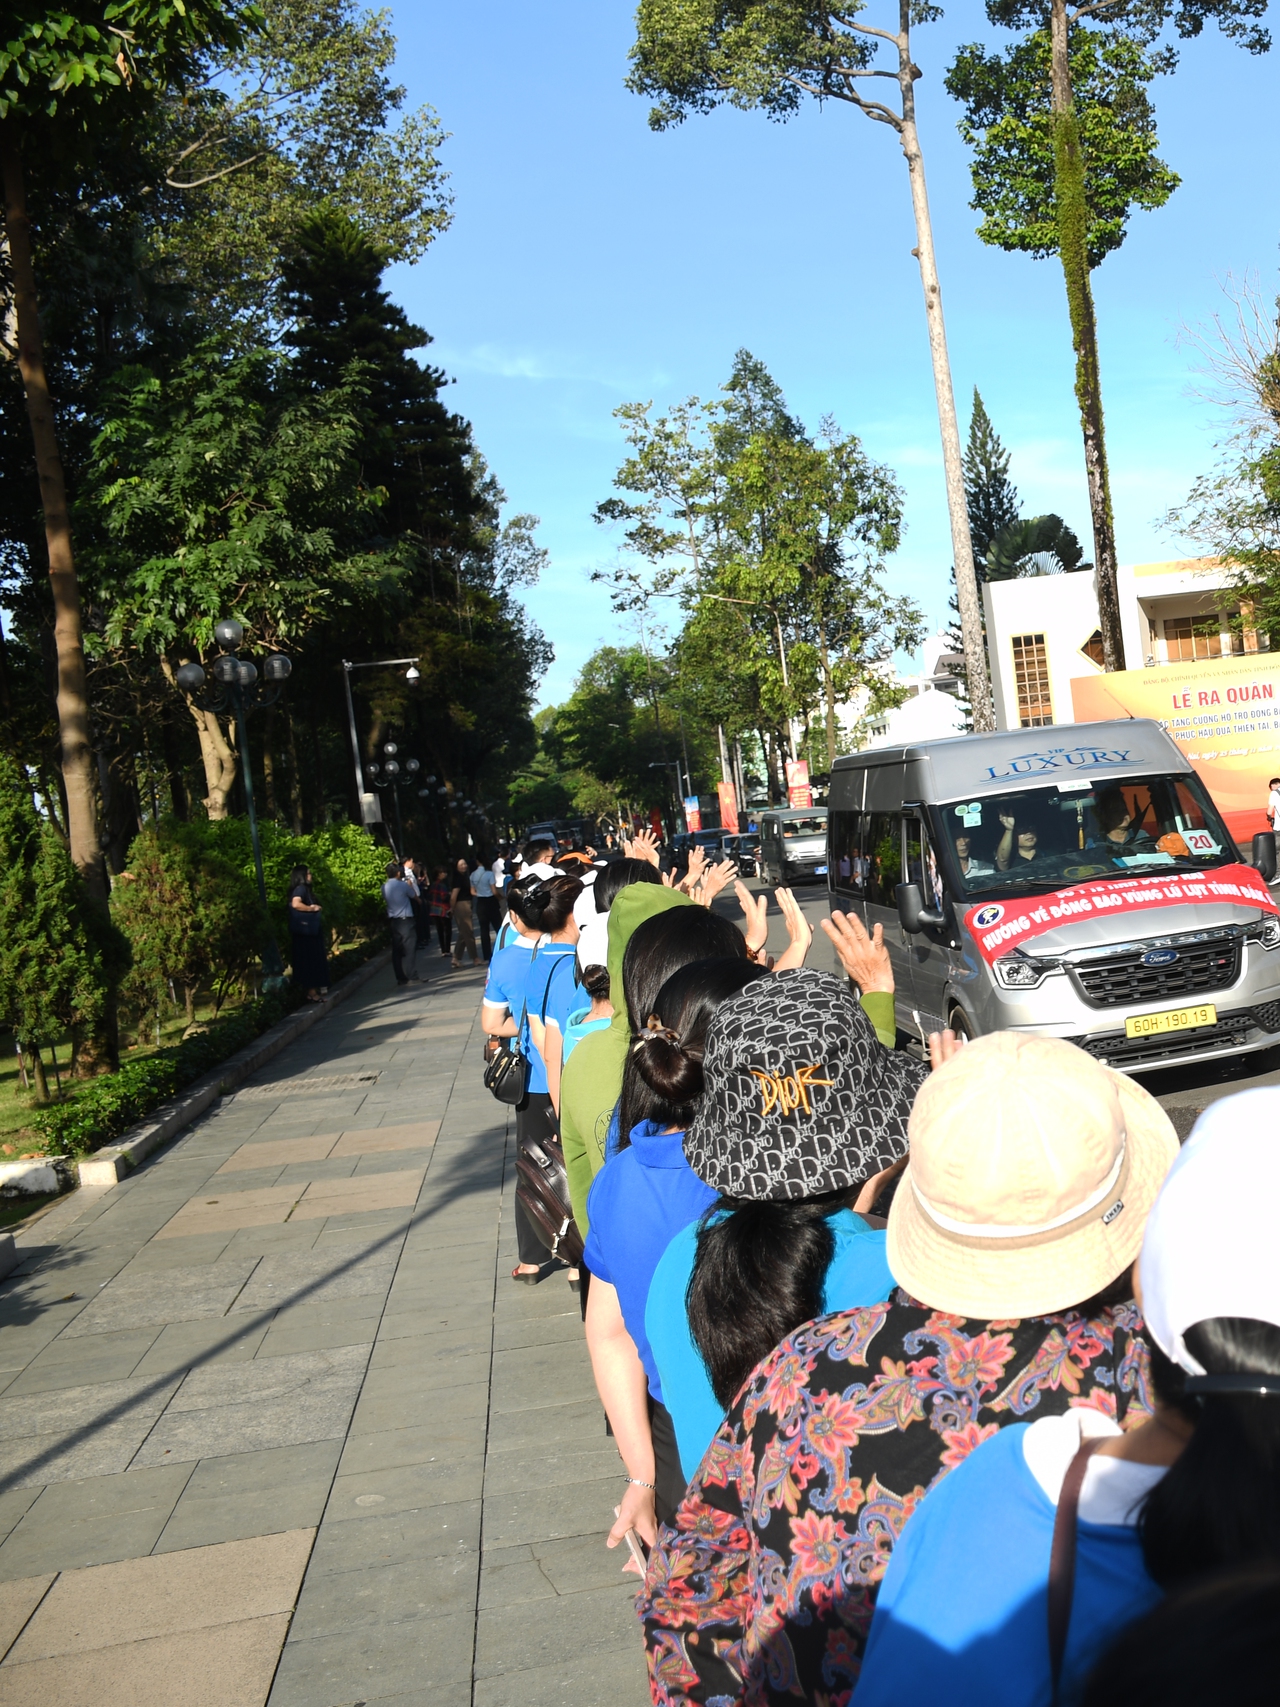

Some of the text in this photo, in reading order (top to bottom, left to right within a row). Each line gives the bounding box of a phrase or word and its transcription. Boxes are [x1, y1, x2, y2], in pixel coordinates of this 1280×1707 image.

[1197, 690, 1221, 706] RA
[1226, 681, 1274, 704] QUÂN
[985, 750, 1131, 779] LUXURY
[1188, 834, 1213, 849] 20
[1049, 899, 1093, 919] ĐỒNG
[1120, 888, 1164, 904] VÙNG
[1181, 884, 1209, 899] LỤT
[1149, 952, 1171, 964] Ford
[1134, 1009, 1208, 1033] 60H-190.19
